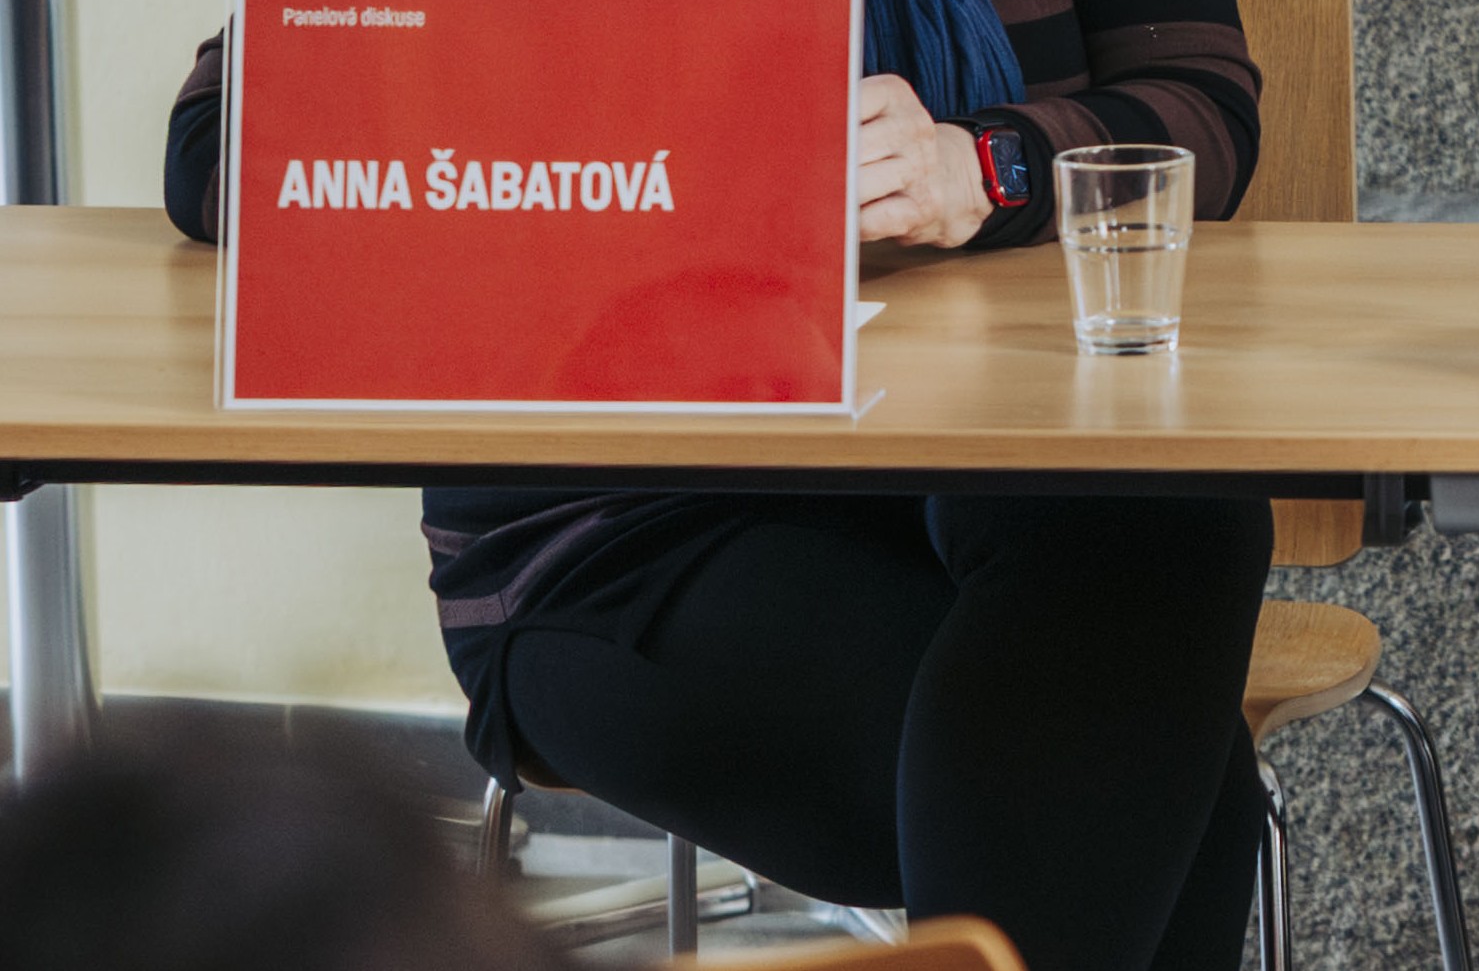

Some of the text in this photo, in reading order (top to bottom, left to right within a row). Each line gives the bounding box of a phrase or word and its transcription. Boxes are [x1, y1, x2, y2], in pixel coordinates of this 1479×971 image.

[282, 5, 426, 29] Panelová diskuse
[277, 148, 675, 212] ANNA ŠABATOVÁ
